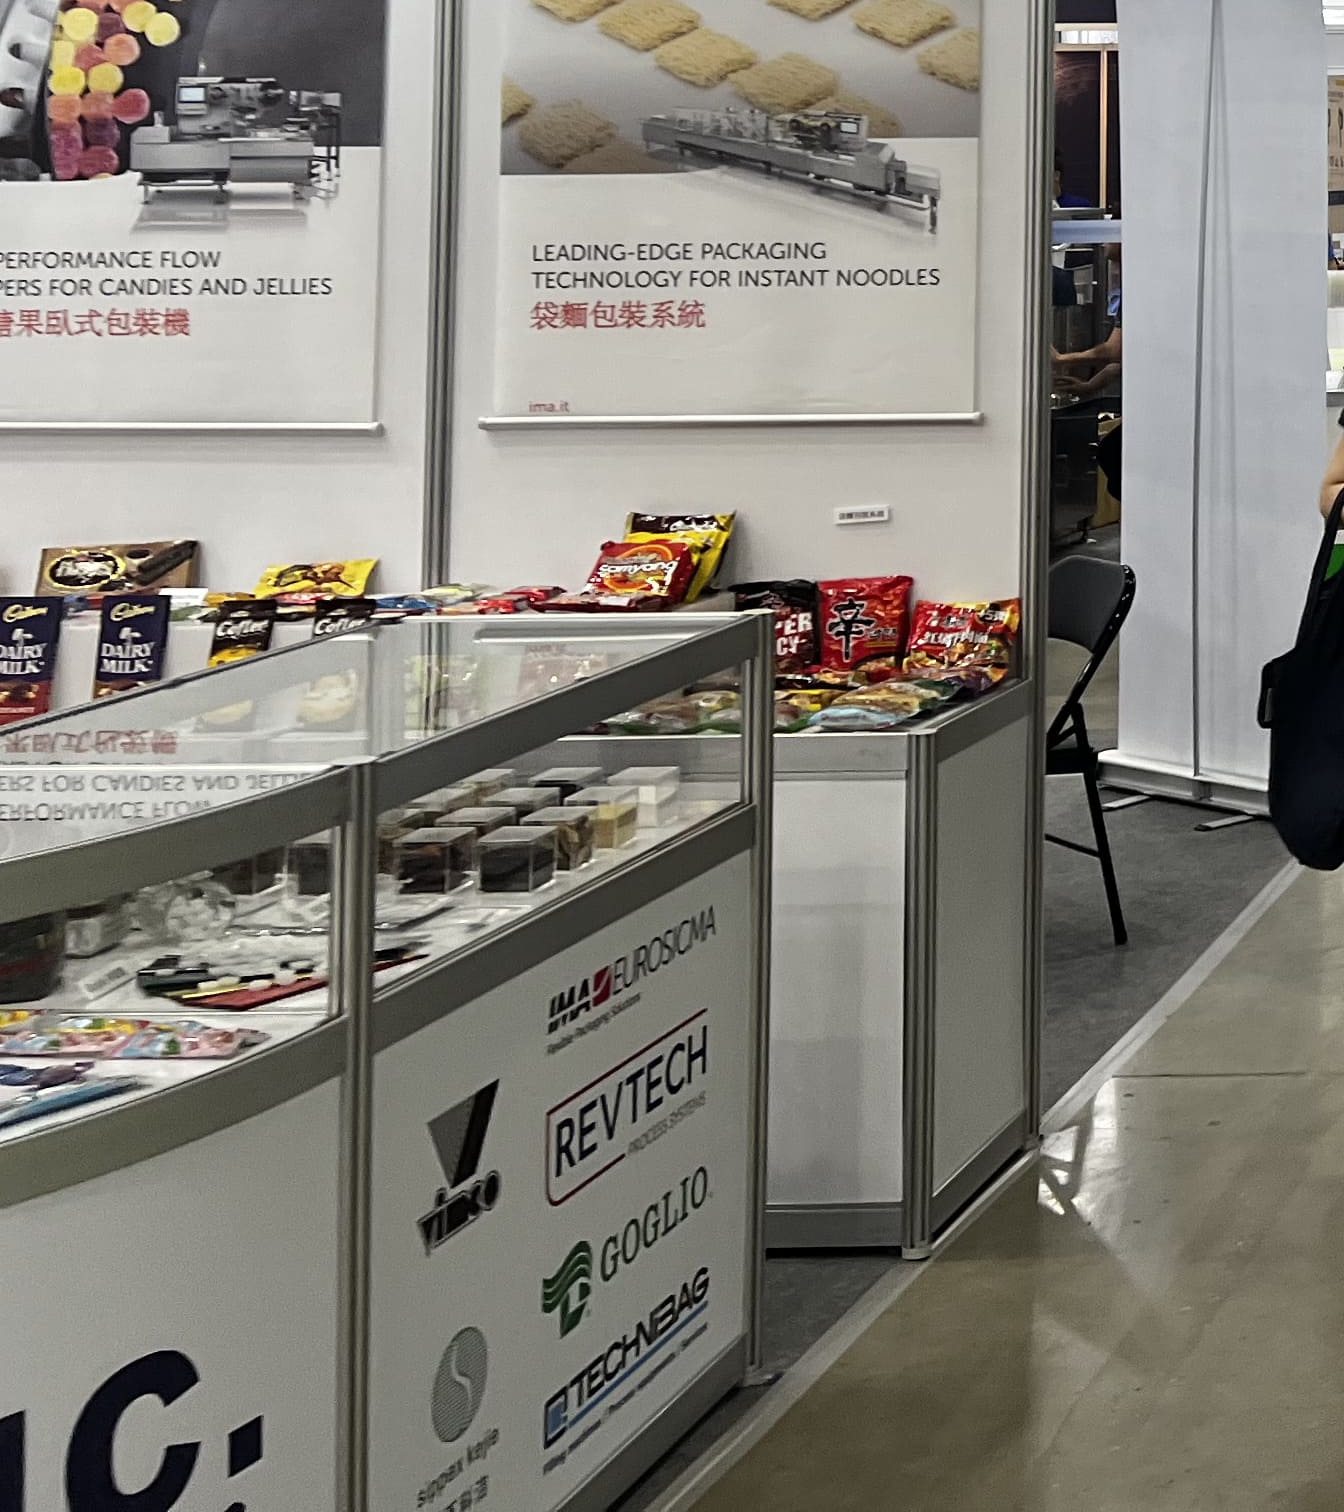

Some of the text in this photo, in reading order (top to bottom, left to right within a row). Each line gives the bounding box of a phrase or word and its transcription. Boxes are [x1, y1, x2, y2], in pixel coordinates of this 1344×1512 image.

[160, 251, 221, 268] FLOW
[532, 242, 827, 262] LEADING-EDGE PACKAGING
[0, 278, 333, 296] ERS FOR CANDIES AND JELLIES
[532, 268, 941, 289] TECHNOLOGY FOR INSTANT NOODLES
[530, 300, 706, 330] 袋麵包裝系統
[598, 559, 679, 585] samyang
[826, 597, 875, 663] 辛
[101, 642, 156, 659] DAIRY
[100, 659, 152, 675] MILK
[612, 905, 716, 996] EUROSICMA
[555, 1024, 708, 1178] REVTECH
[600, 1165, 709, 1282] GOGLIO
[0, 1350, 263, 1512] C.
